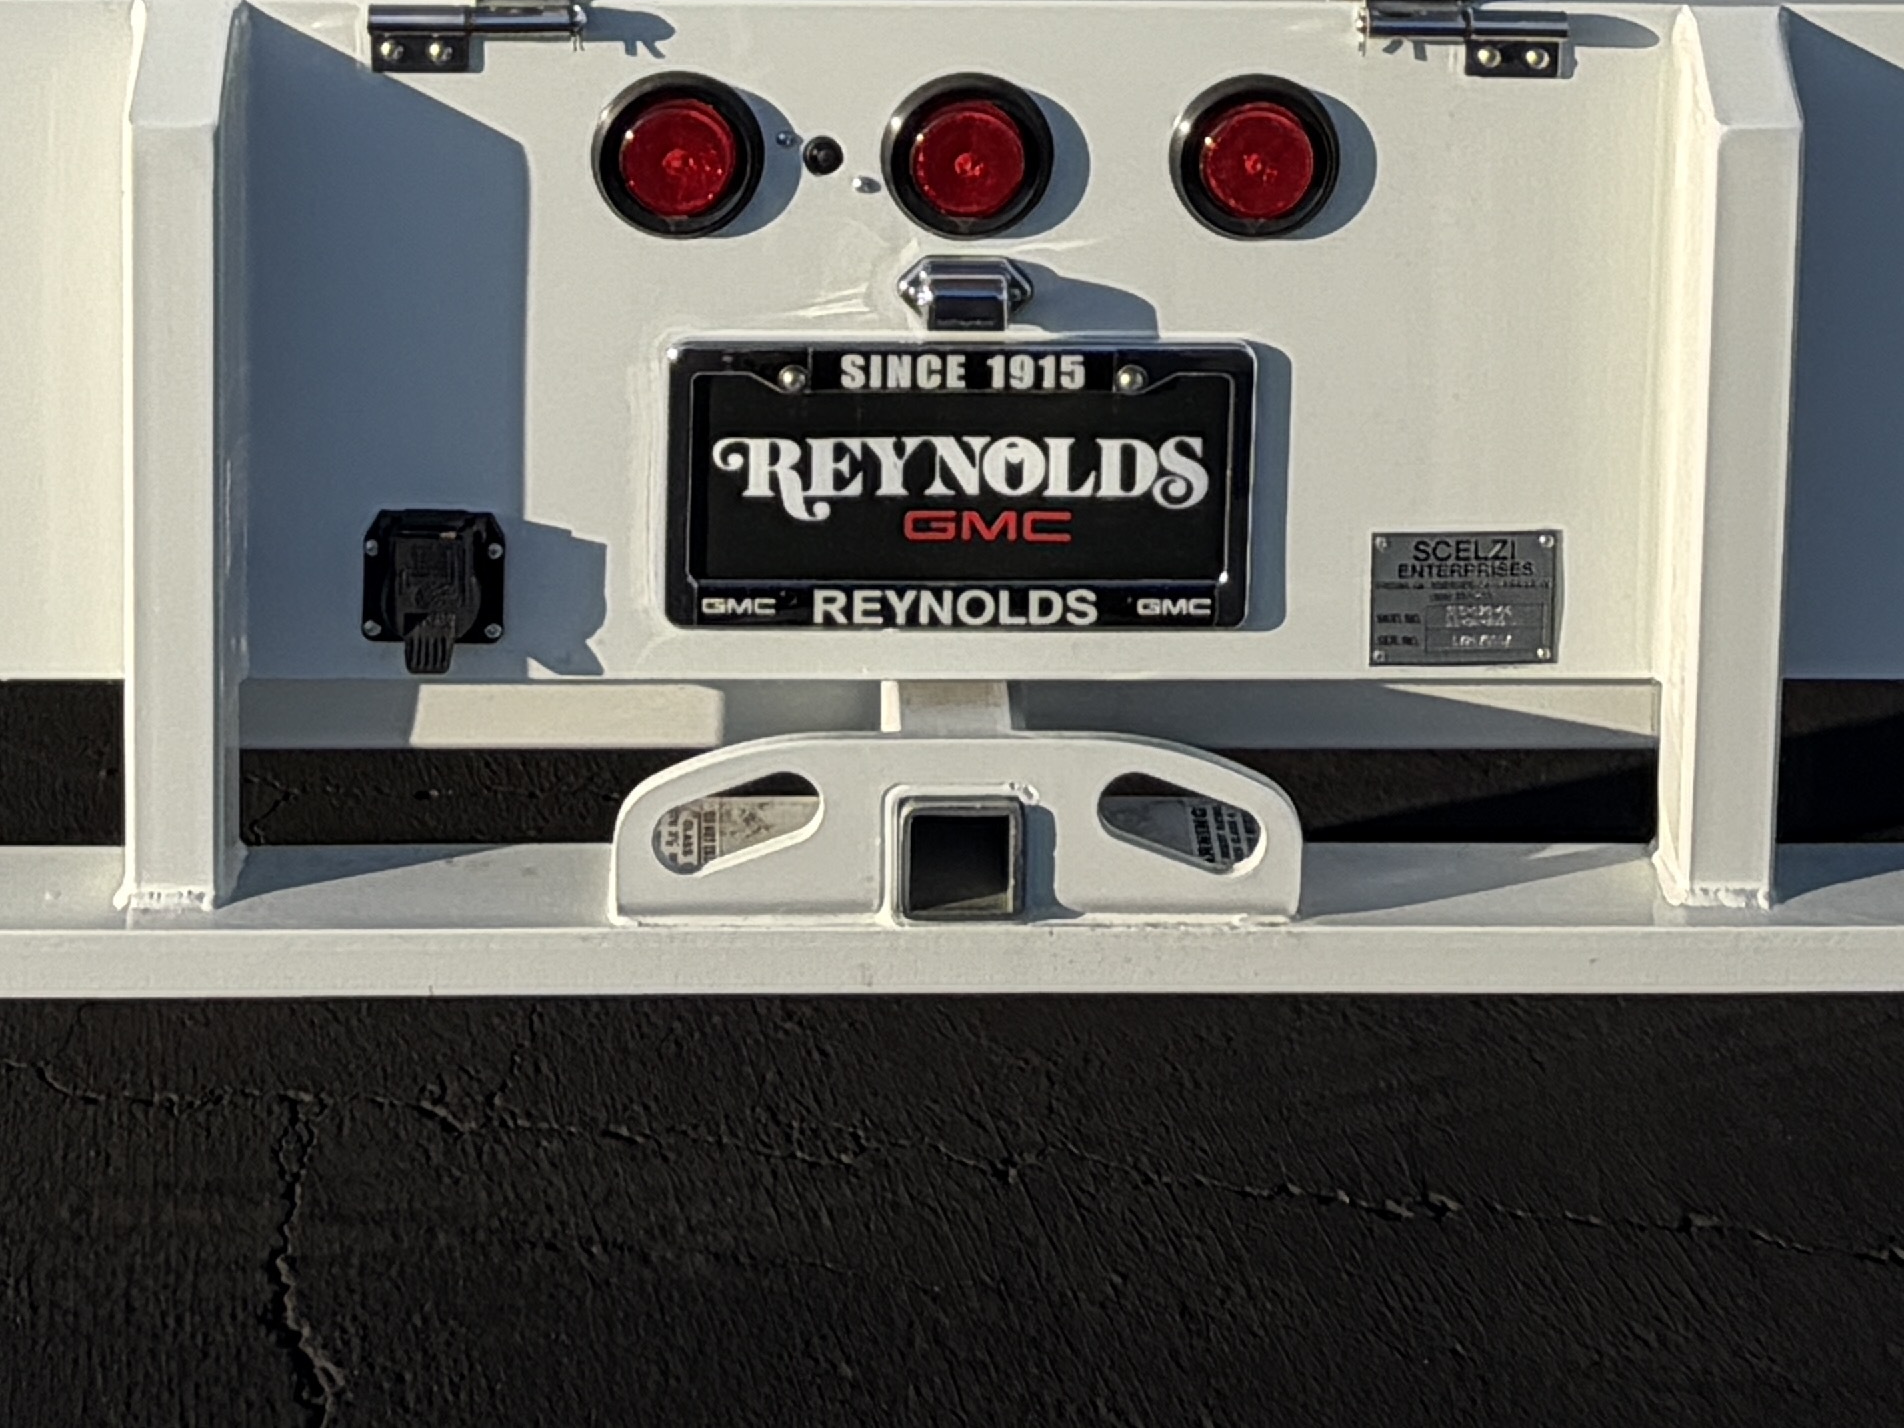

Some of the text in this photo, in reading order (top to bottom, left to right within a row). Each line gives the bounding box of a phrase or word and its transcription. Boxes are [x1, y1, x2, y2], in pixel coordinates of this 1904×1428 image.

[840, 354, 1087, 390] SINCE 1915
[711, 435, 1210, 522] REYNOLDS
[903, 510, 1073, 542] GMC
[1412, 538, 1517, 563] SCELZI
[1398, 561, 1535, 580] ENTERPRISES
[701, 588, 1213, 626] GMC REYNOLDS GMC
